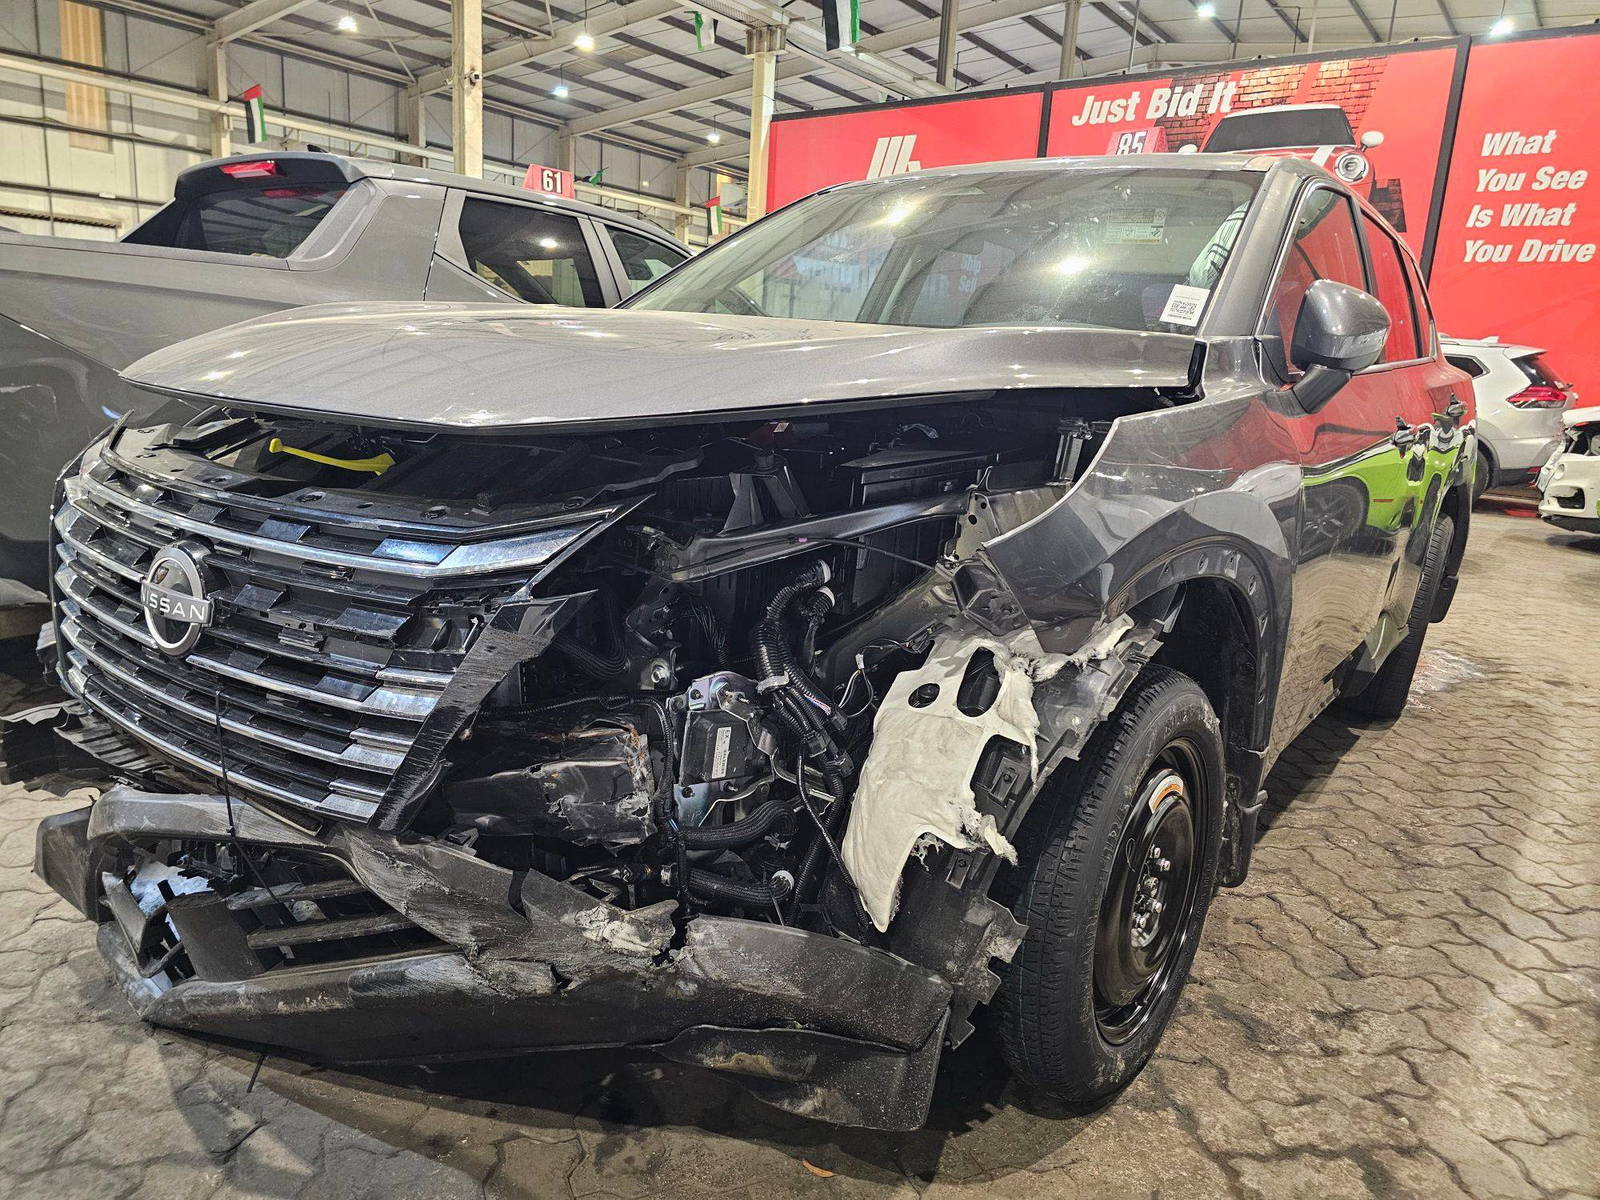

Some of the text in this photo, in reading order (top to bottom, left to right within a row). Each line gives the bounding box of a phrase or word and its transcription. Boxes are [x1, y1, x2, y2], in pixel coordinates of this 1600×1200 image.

[1072, 80, 1239, 126] Just Bid It
[1117, 131, 1147, 155] 85
[1480, 129, 1557, 157] What
[542, 169, 562, 194] 61
[1476, 166, 1588, 192] You See
[1465, 202, 1577, 228] Is What
[1463, 238, 1597, 263] You Drive
